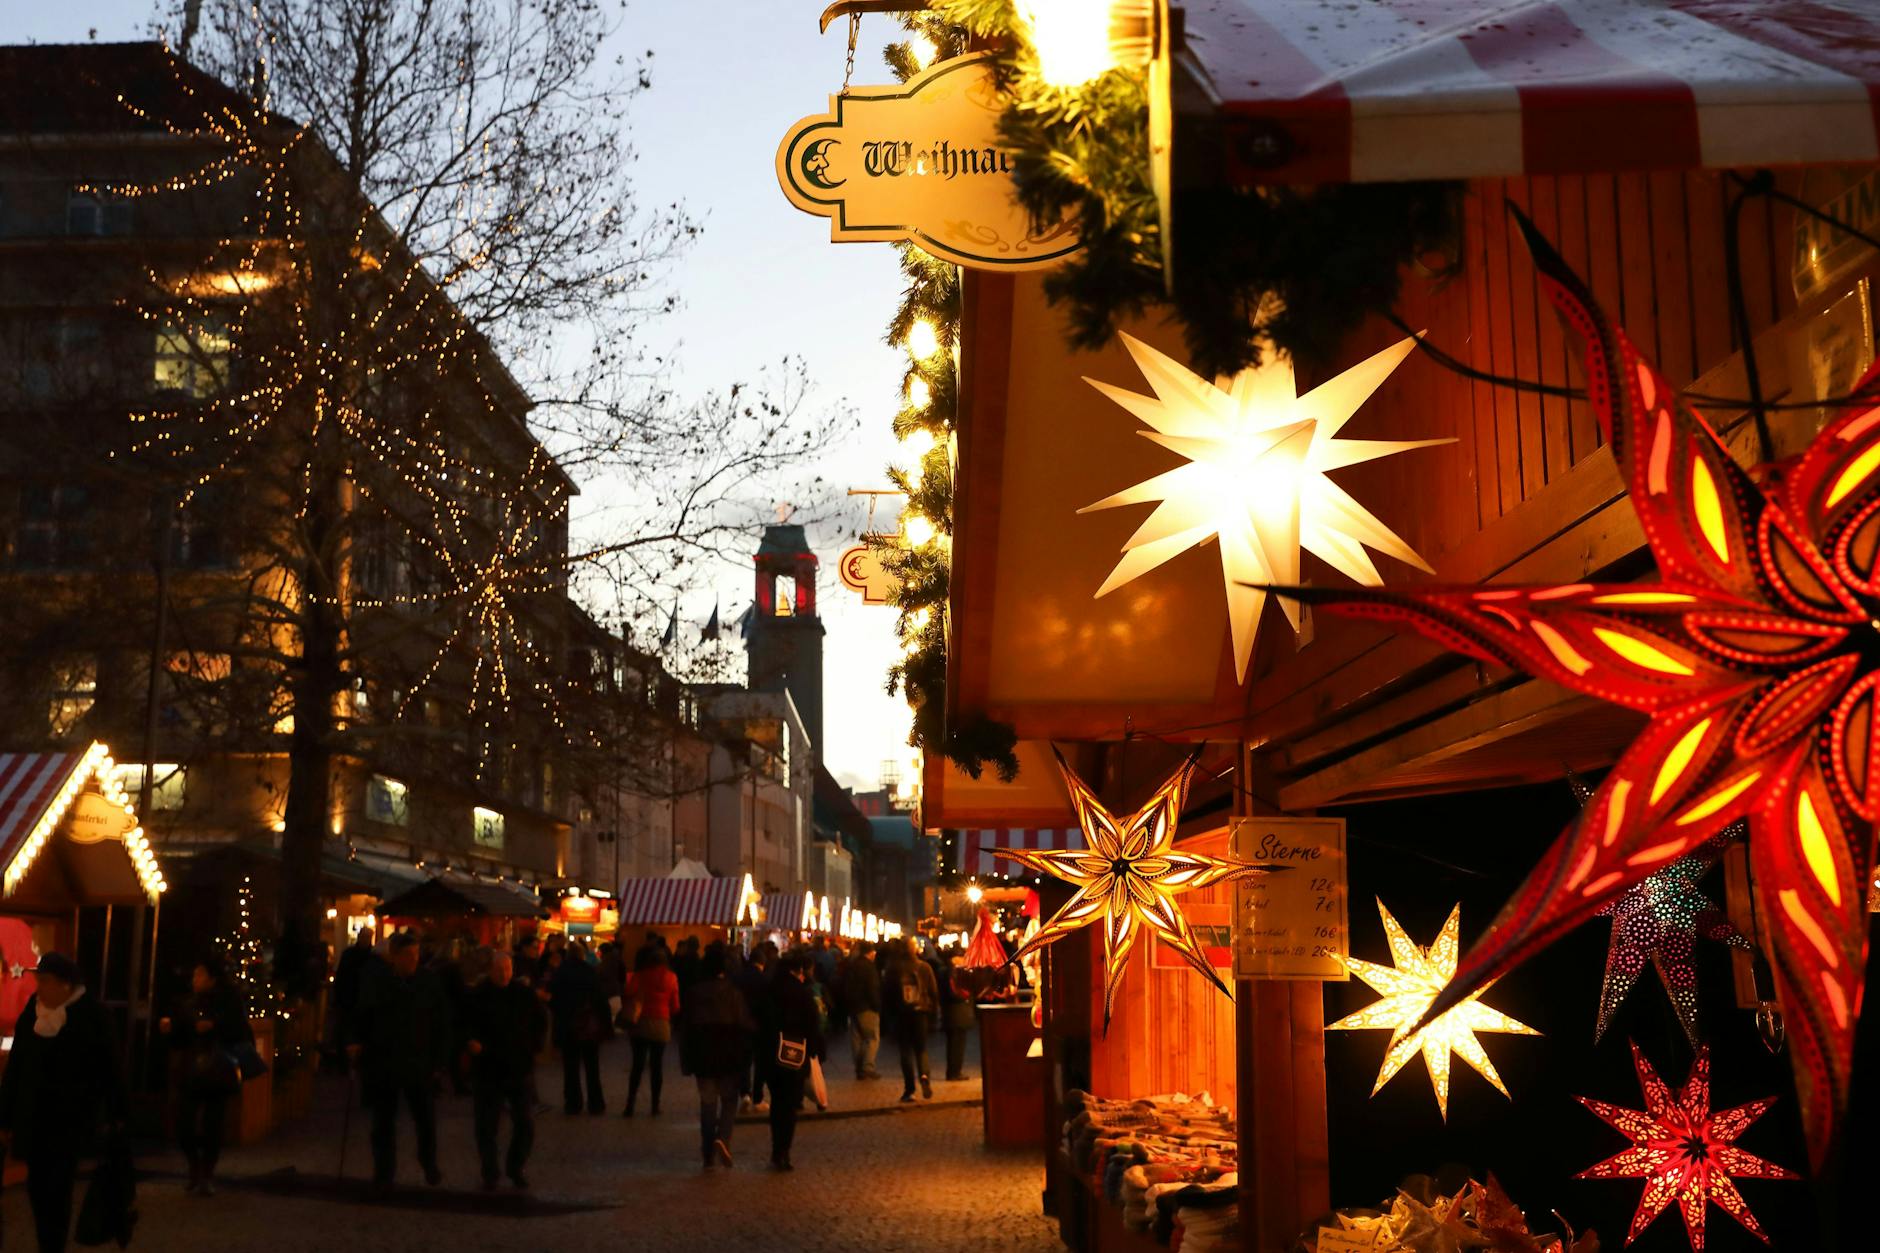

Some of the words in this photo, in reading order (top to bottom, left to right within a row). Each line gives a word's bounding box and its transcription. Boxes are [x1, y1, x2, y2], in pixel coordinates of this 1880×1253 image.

[1254, 833, 1321, 861] Sterne
[1310, 878, 1336, 893] 12€
[1313, 925, 1337, 938] 16€
